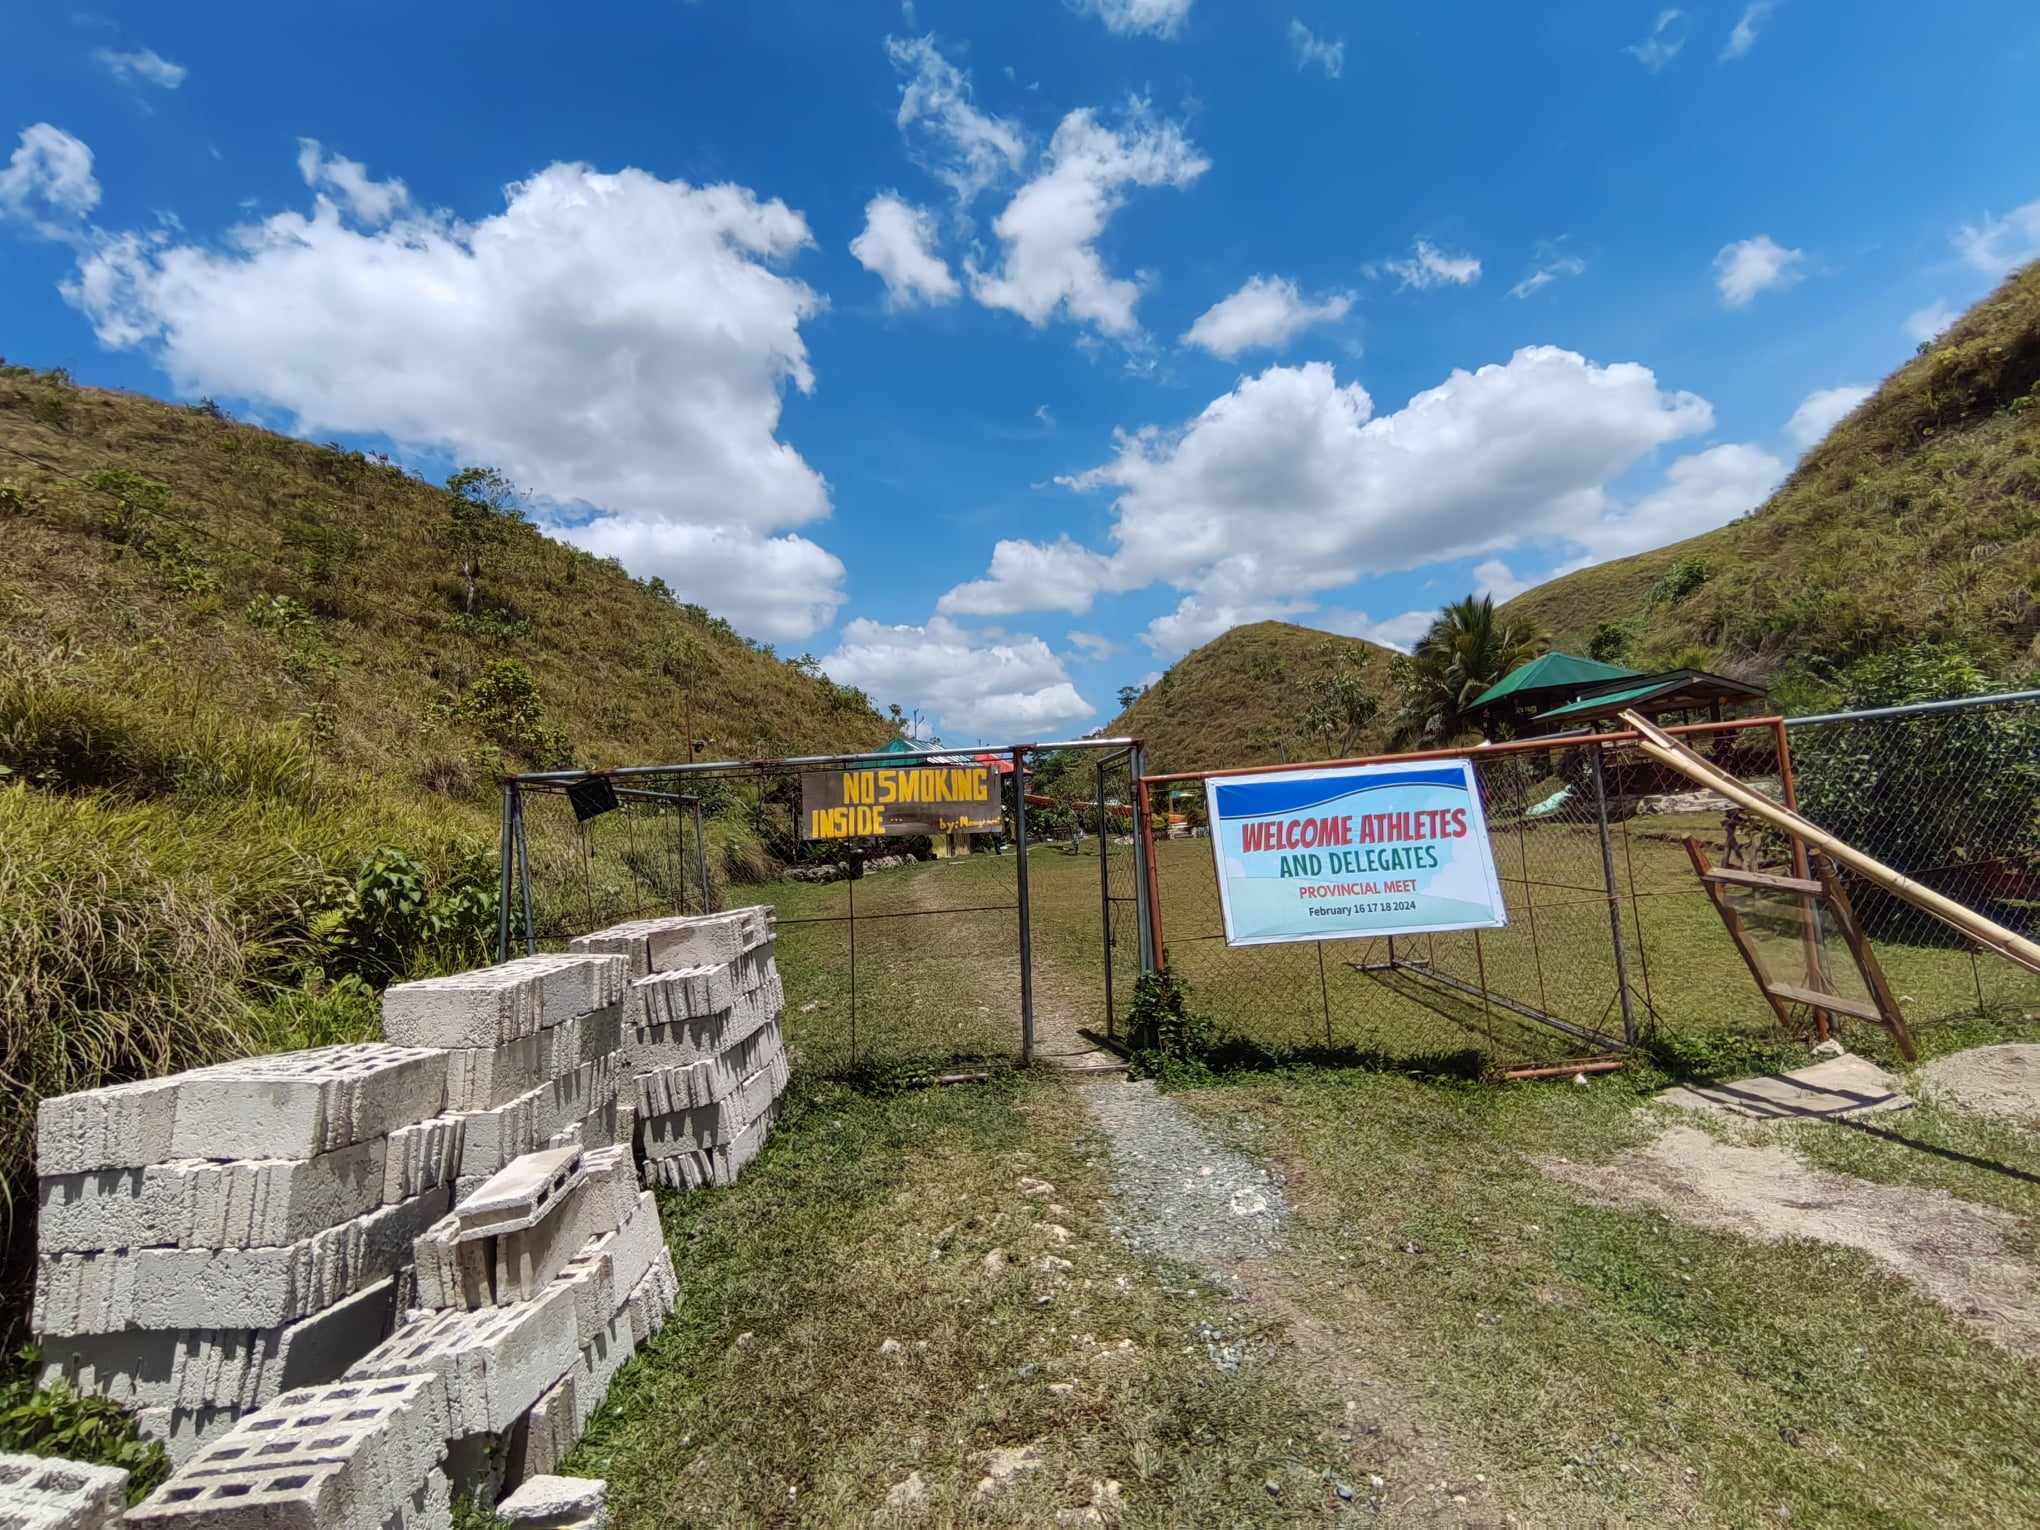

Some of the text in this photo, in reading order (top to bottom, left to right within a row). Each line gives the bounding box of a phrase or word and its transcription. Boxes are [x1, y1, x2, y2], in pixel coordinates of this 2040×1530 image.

[843, 768, 988, 804] NO SMOKING
[1242, 807, 1468, 853] WELCOME ATHLETES
[1280, 845, 1439, 878] AND DELEGATES
[1299, 879, 1417, 899] PROVINCIAL MEET
[1309, 900, 1416, 917] February 16 17 18 2024
